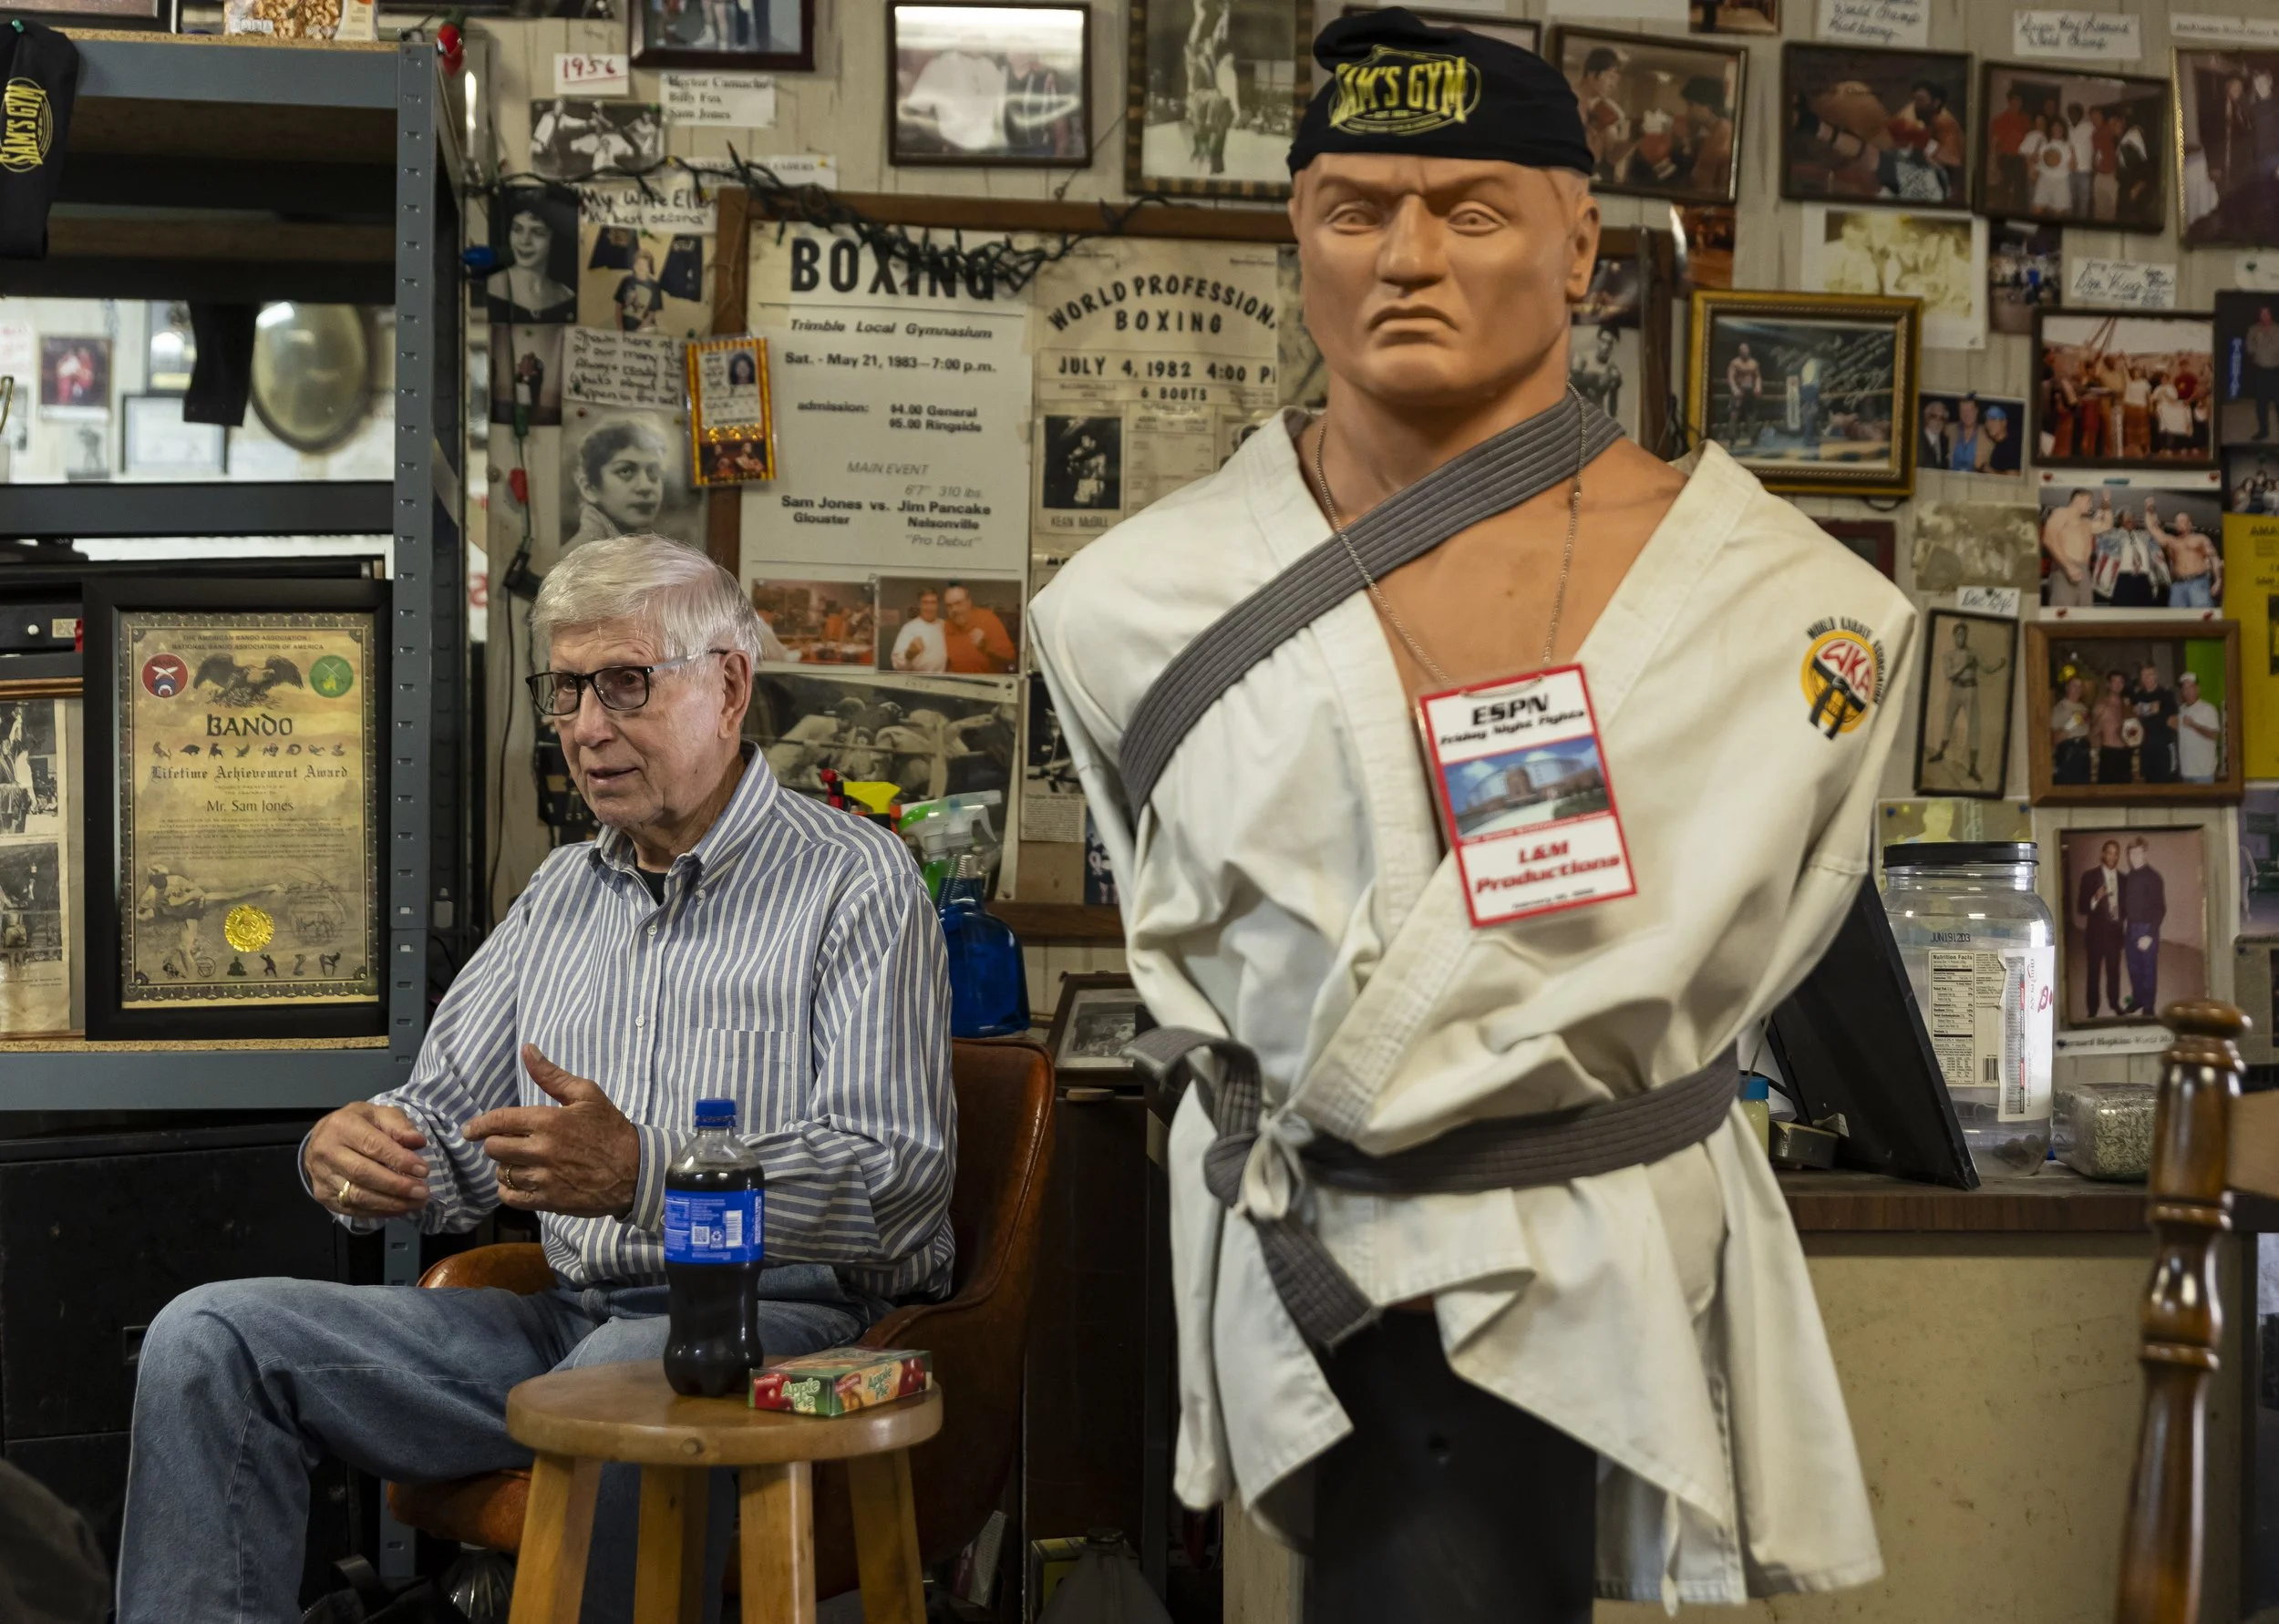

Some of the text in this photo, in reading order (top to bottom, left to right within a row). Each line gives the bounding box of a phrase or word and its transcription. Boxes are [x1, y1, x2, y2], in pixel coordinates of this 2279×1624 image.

[561, 57, 616, 79] 1956
[1407, 57, 1467, 123] GYM
[0, 85, 46, 165] SAM'S GYM
[791, 236, 995, 301] BOXING
[1047, 281, 1128, 332] WORLD
[790, 319, 993, 339] Trimble Local Gymnasium
[1114, 309, 1222, 334] BOXING
[784, 351, 814, 365] Sat.
[827, 353, 859, 368] May
[862, 354, 883, 369] 21,
[963, 360, 997, 374] p.m.
[1057, 356, 1107, 375] JULY
[1119, 358, 1140, 379] 4,
[1146, 360, 1192, 378] 1982
[1206, 363, 1248, 382] 4:00
[1140, 385, 1208, 401] 6 BOUTS
[797, 399, 871, 413] admission:
[926, 404, 978, 417] General
[924, 418, 983, 433] Ringside
[846, 461, 930, 475] MAIN EVENT
[780, 495, 992, 516] Sam Jones vs. Jim Pancake
[793, 511, 851, 525] Glouster
[907, 516, 980, 530] Nelsonville
[1821, 641, 1871, 692] WKA
[1470, 693, 1549, 726] ESPN
[206, 713, 293, 737] BANDO
[1440, 710, 1584, 745] Friday Night Fights
[150, 764, 348, 785] Lifetime Achievement Award
[207, 799, 294, 813] Mr. Sam Jones
[1518, 840, 1570, 864] L&M
[1475, 856, 1620, 893] Productions
[780, 1377, 820, 1398] Apple
[868, 1364, 892, 1390] Apple
[794, 1393, 816, 1410] Pie
[875, 1383, 890, 1401] Pie
